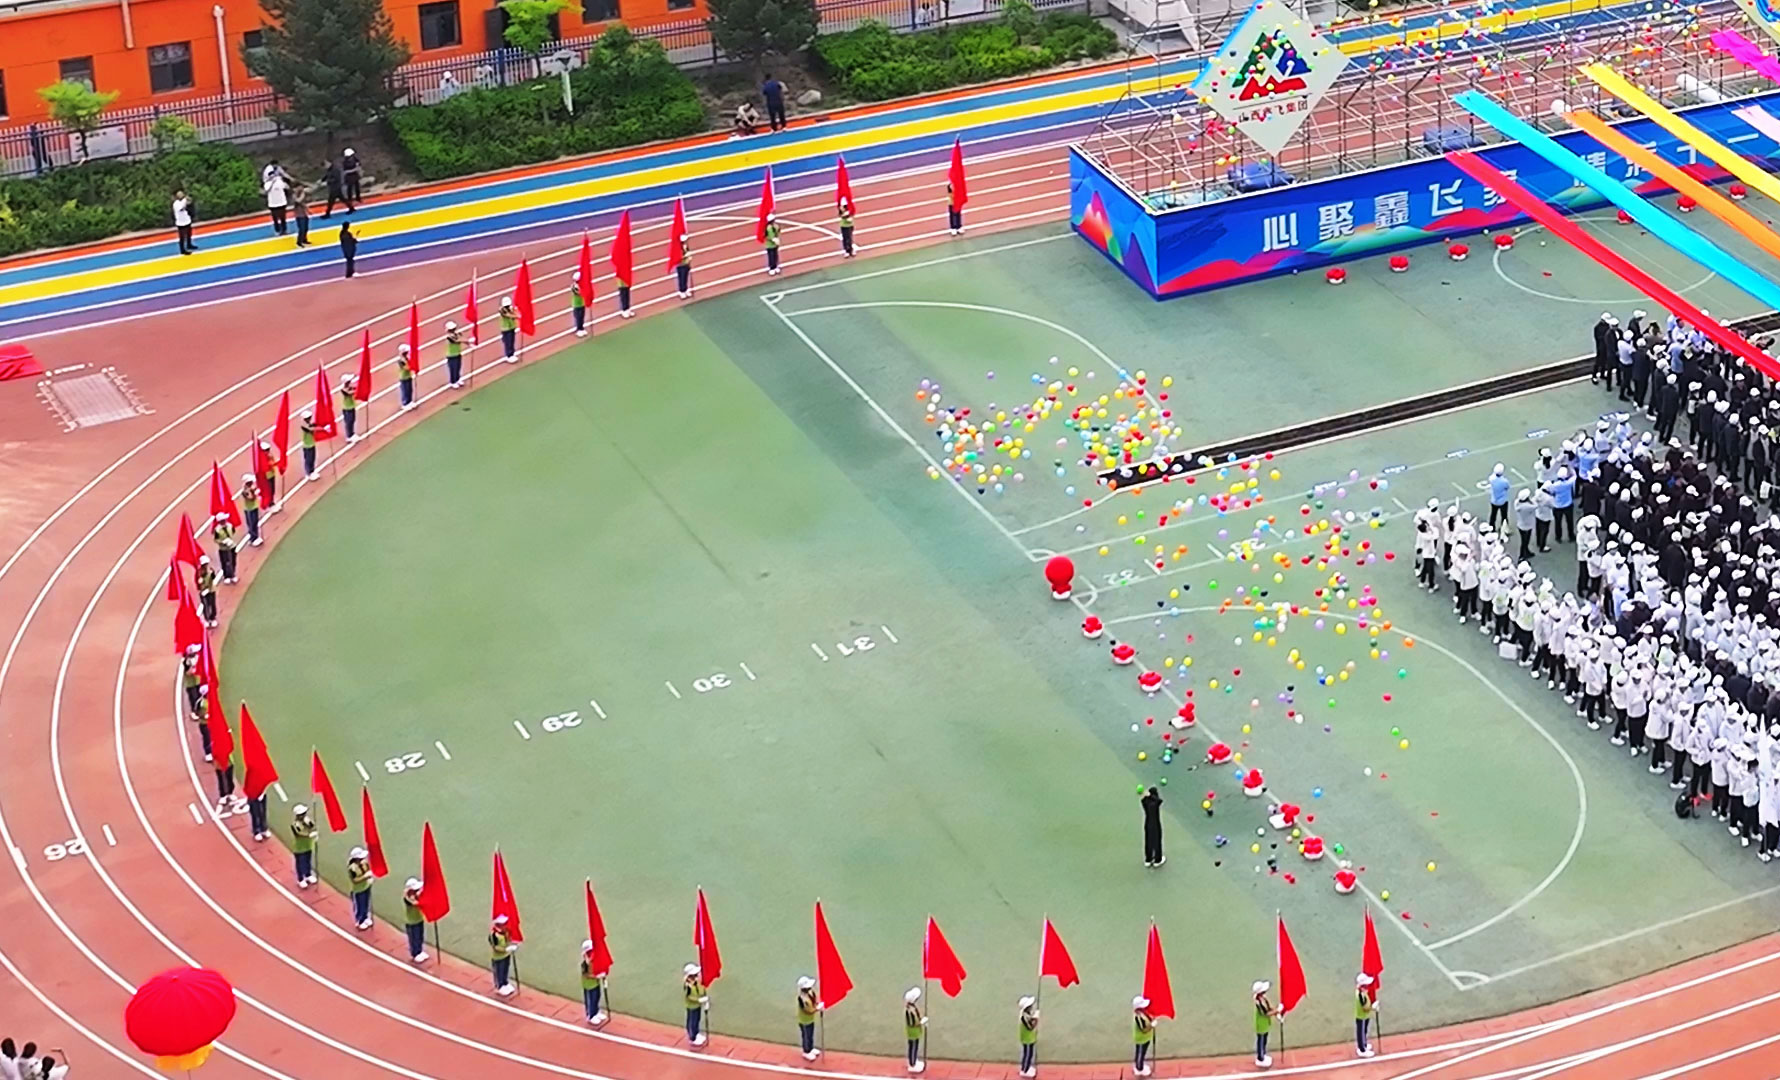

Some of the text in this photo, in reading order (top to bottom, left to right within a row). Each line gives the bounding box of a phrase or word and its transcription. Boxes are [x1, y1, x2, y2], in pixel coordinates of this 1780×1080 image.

[836, 635, 876, 657] 31
[692, 672, 732, 694] 30
[541, 710, 583, 734] 29
[384, 751, 426, 774] 28
[214, 796, 250, 820] 27
[43, 837, 87, 861] 26
